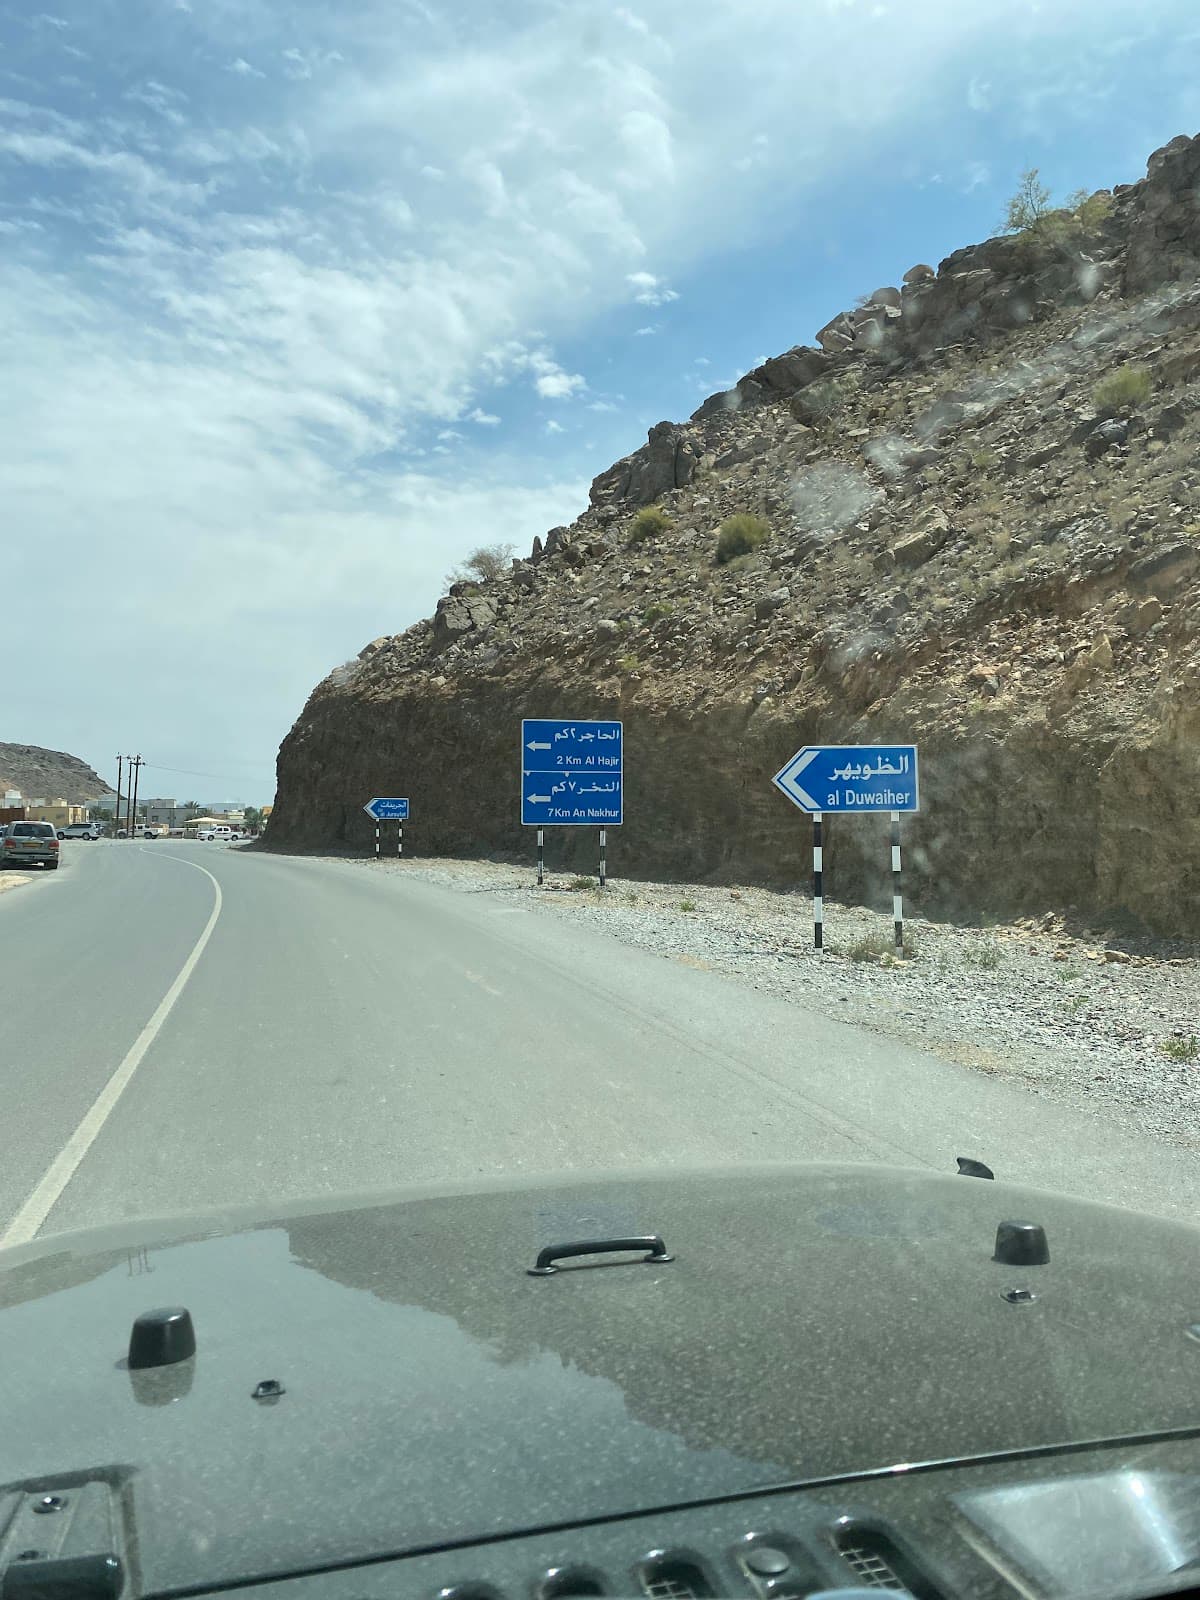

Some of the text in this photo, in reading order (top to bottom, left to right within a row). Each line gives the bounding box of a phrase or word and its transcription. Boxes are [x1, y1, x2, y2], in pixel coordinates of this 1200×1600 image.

[577, 729, 620, 742] الحاجر
[565, 756, 582, 765] Km
[585, 756, 595, 765] Al
[598, 756, 620, 767] Hajir
[827, 789, 911, 806] al Duwaiher
[572, 808, 586, 817] An
[587, 808, 620, 817] Nakhur
